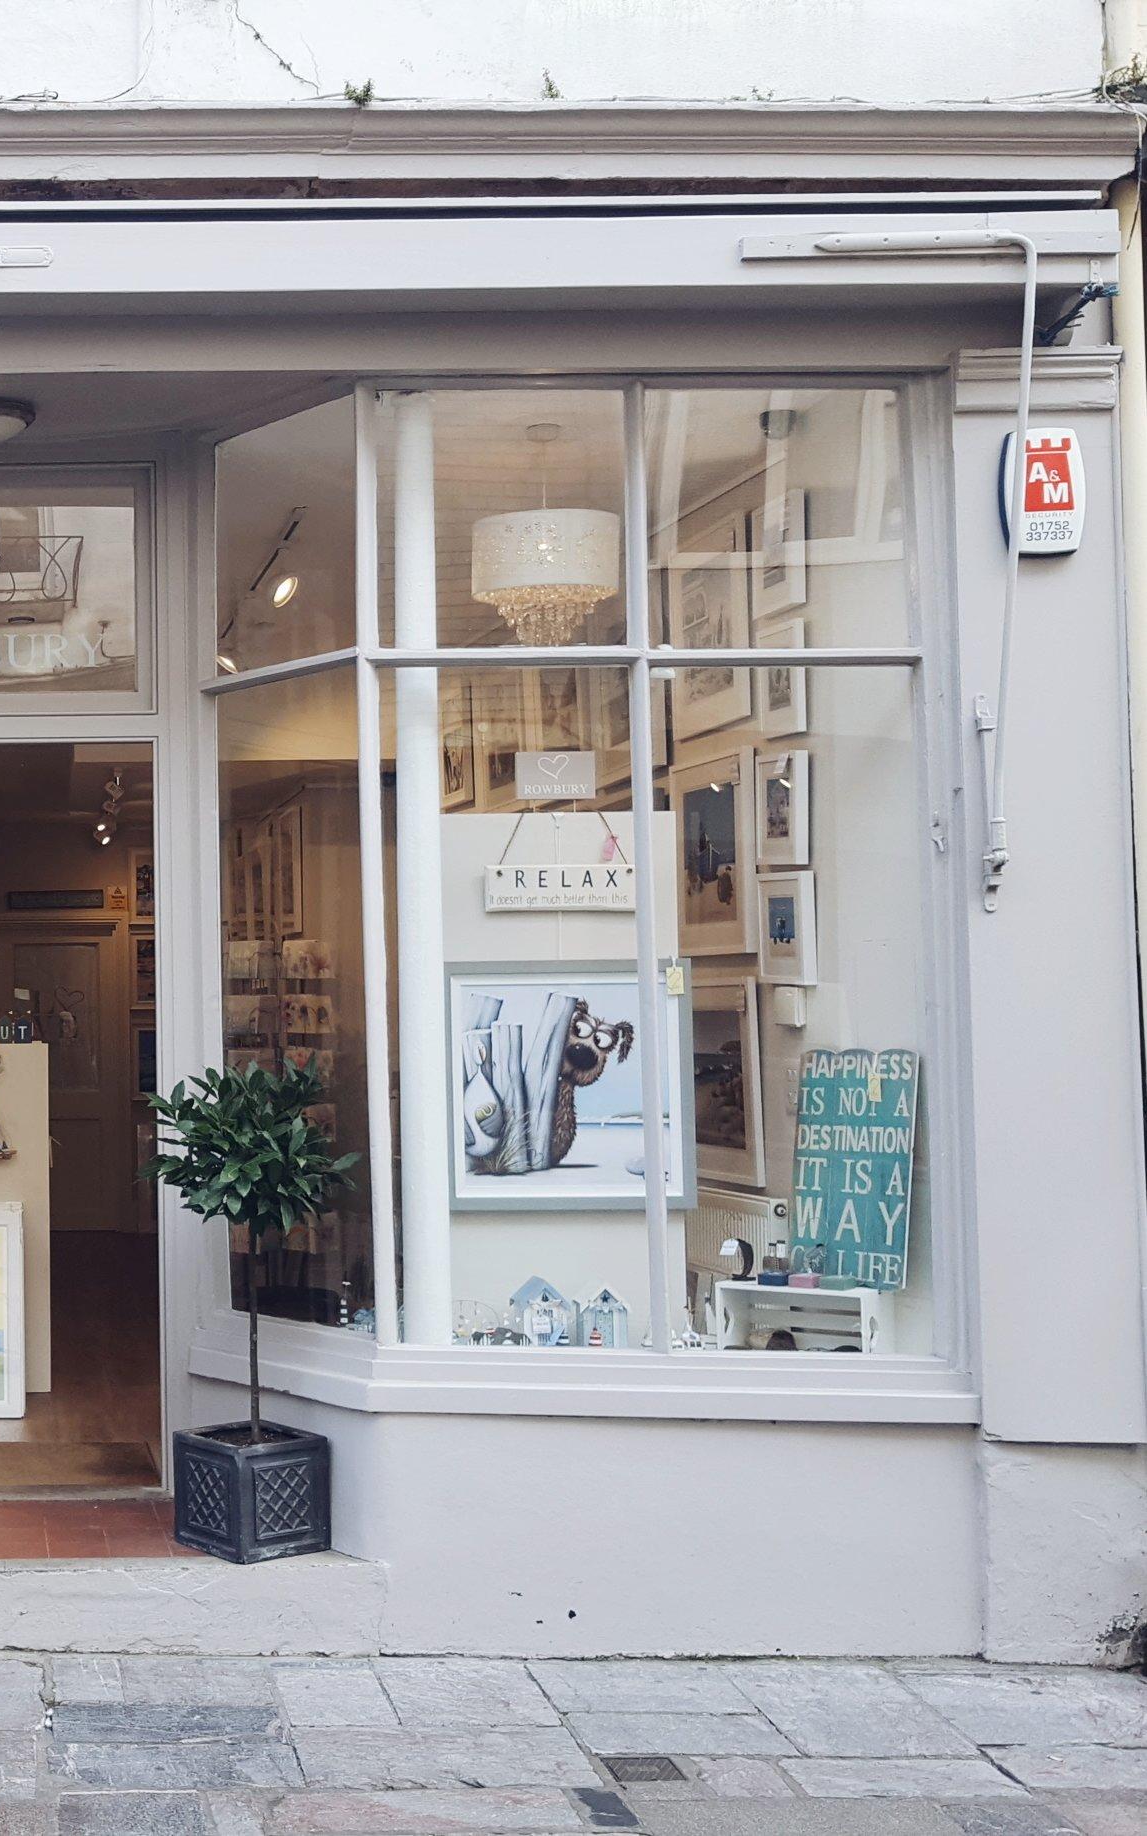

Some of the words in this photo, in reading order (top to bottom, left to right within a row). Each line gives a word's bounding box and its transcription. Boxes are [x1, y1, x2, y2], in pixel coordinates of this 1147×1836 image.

[1025, 530, 1074, 542] 337337
[1029, 520, 1070, 531] 01752
[523, 784, 589, 795] ROWBURY
[514, 869, 618, 889] RELAX
[541, 893, 561, 905] much
[564, 893, 586, 905] better
[611, 892, 629, 904] this
[803, 1053, 913, 1080] HAPPINESS
[799, 1087, 825, 1115] IS
[893, 1088, 911, 1117] A
[797, 1123, 910, 1154] DESTINATION
[795, 1157, 827, 1191] IT
[841, 1159, 872, 1194] IS
[885, 1161, 905, 1196] A
[795, 1195, 905, 1246] WAY
[836, 1249, 902, 1285] LIFE
